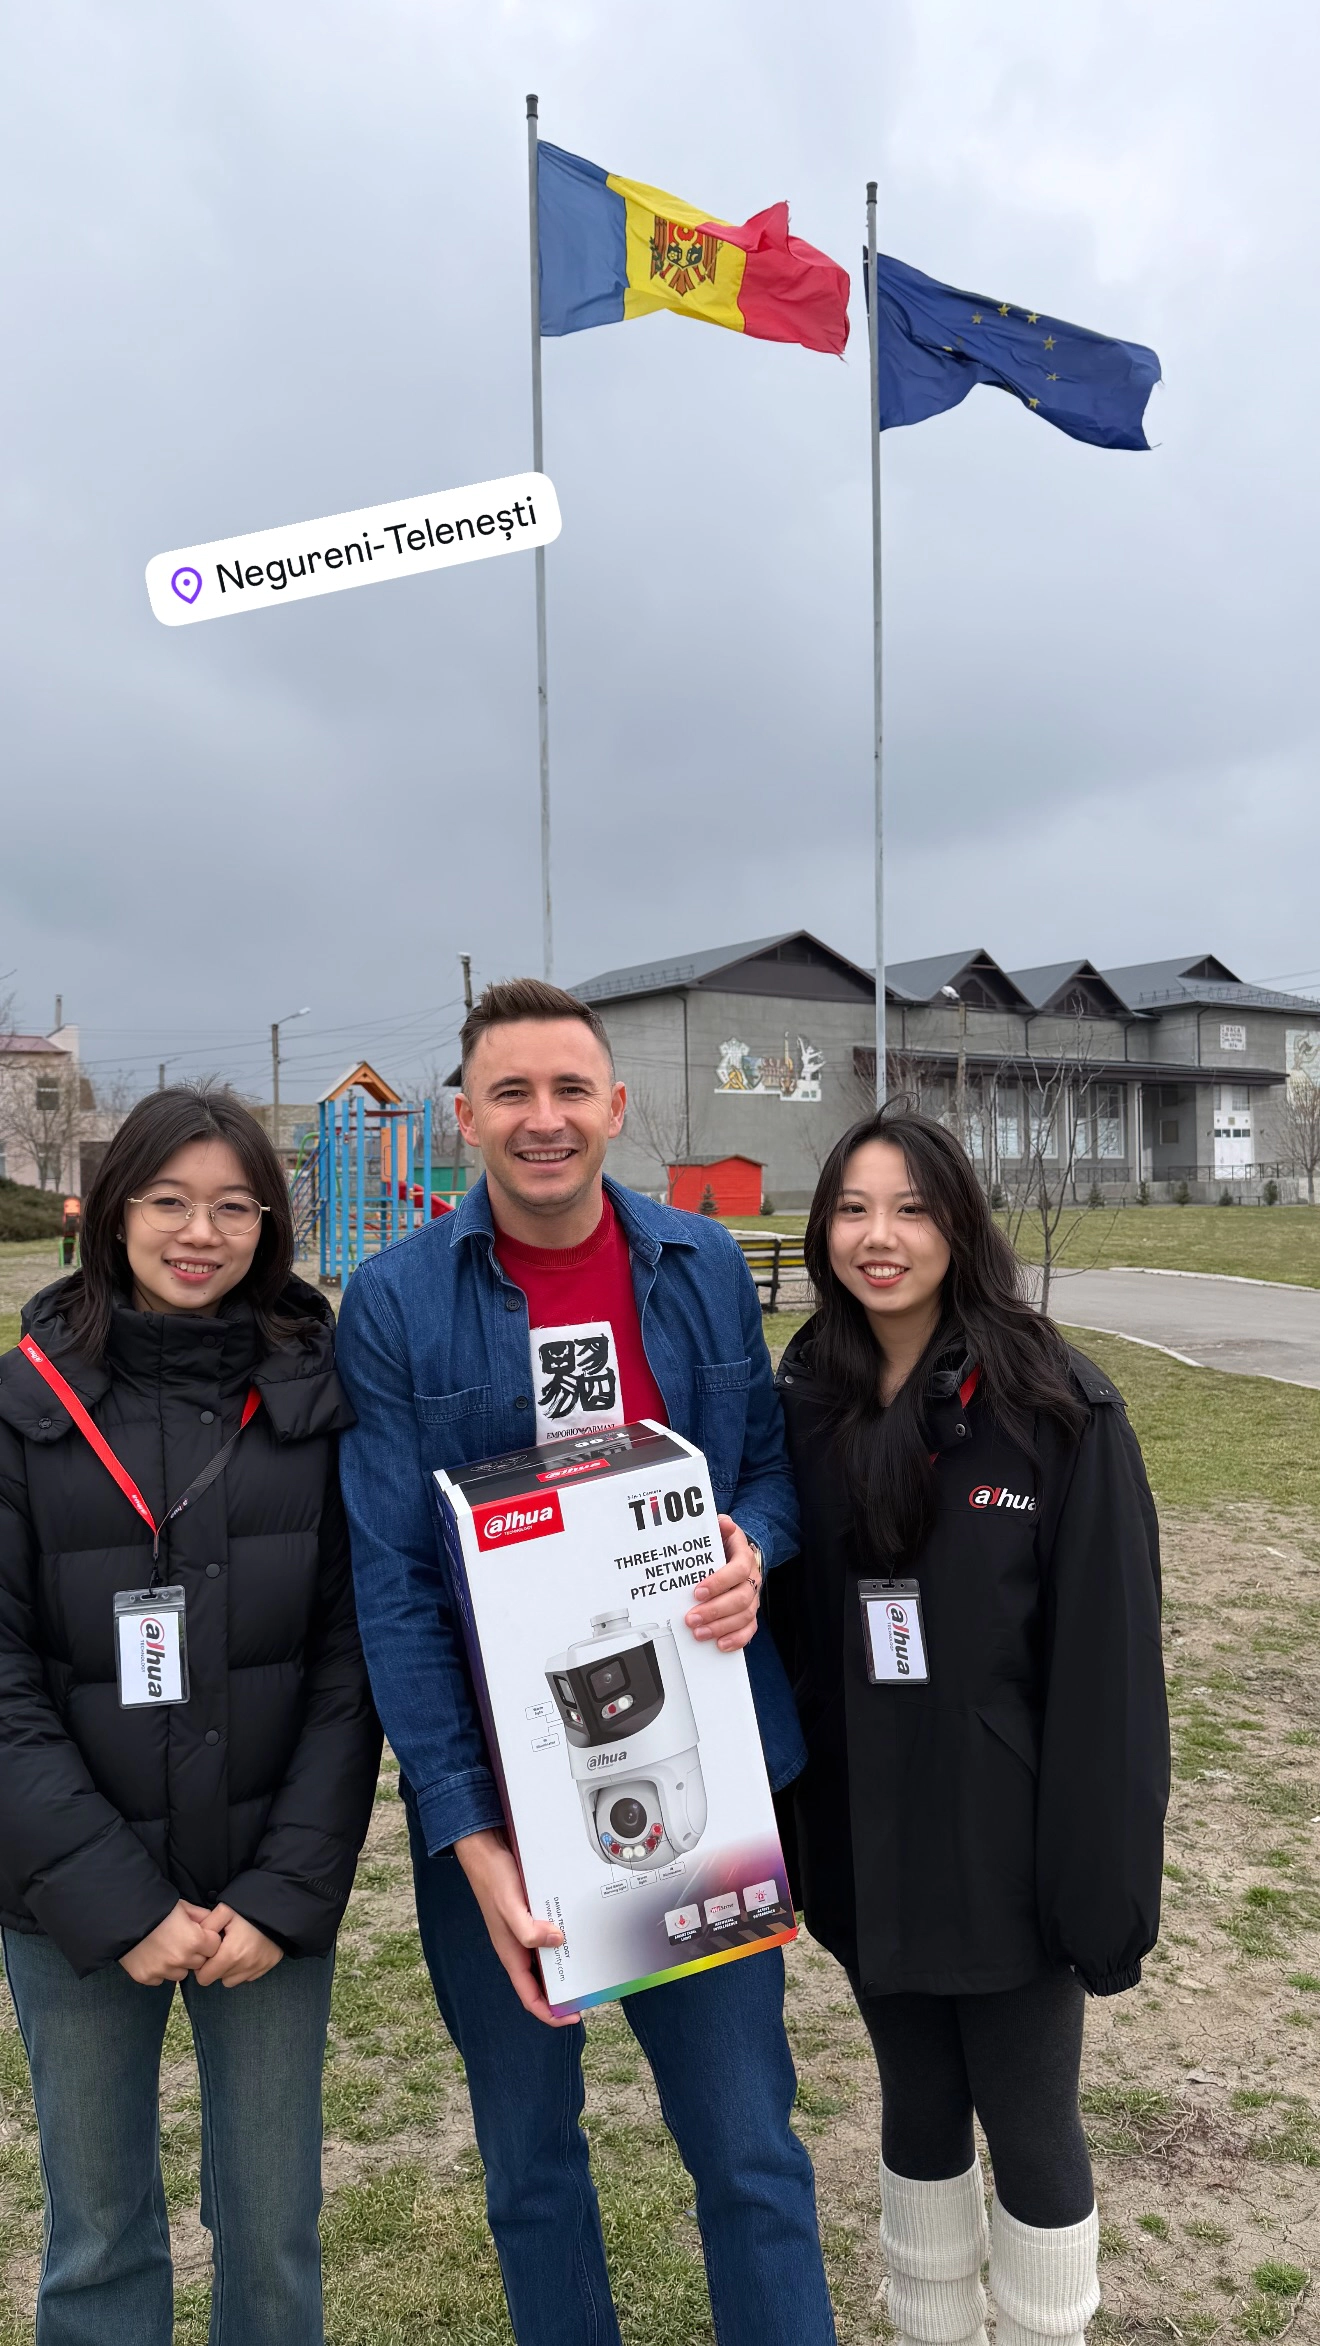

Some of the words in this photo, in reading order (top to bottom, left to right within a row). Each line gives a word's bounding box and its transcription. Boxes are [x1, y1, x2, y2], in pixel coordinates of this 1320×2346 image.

[546, 1427, 580, 1439] EMPORIO
[628, 1486, 705, 1531] TiOC
[614, 1536, 712, 1570] THREE-IN-ONE
[645, 1552, 715, 1579] NETWORK
[630, 1583, 657, 1600] PTZ
